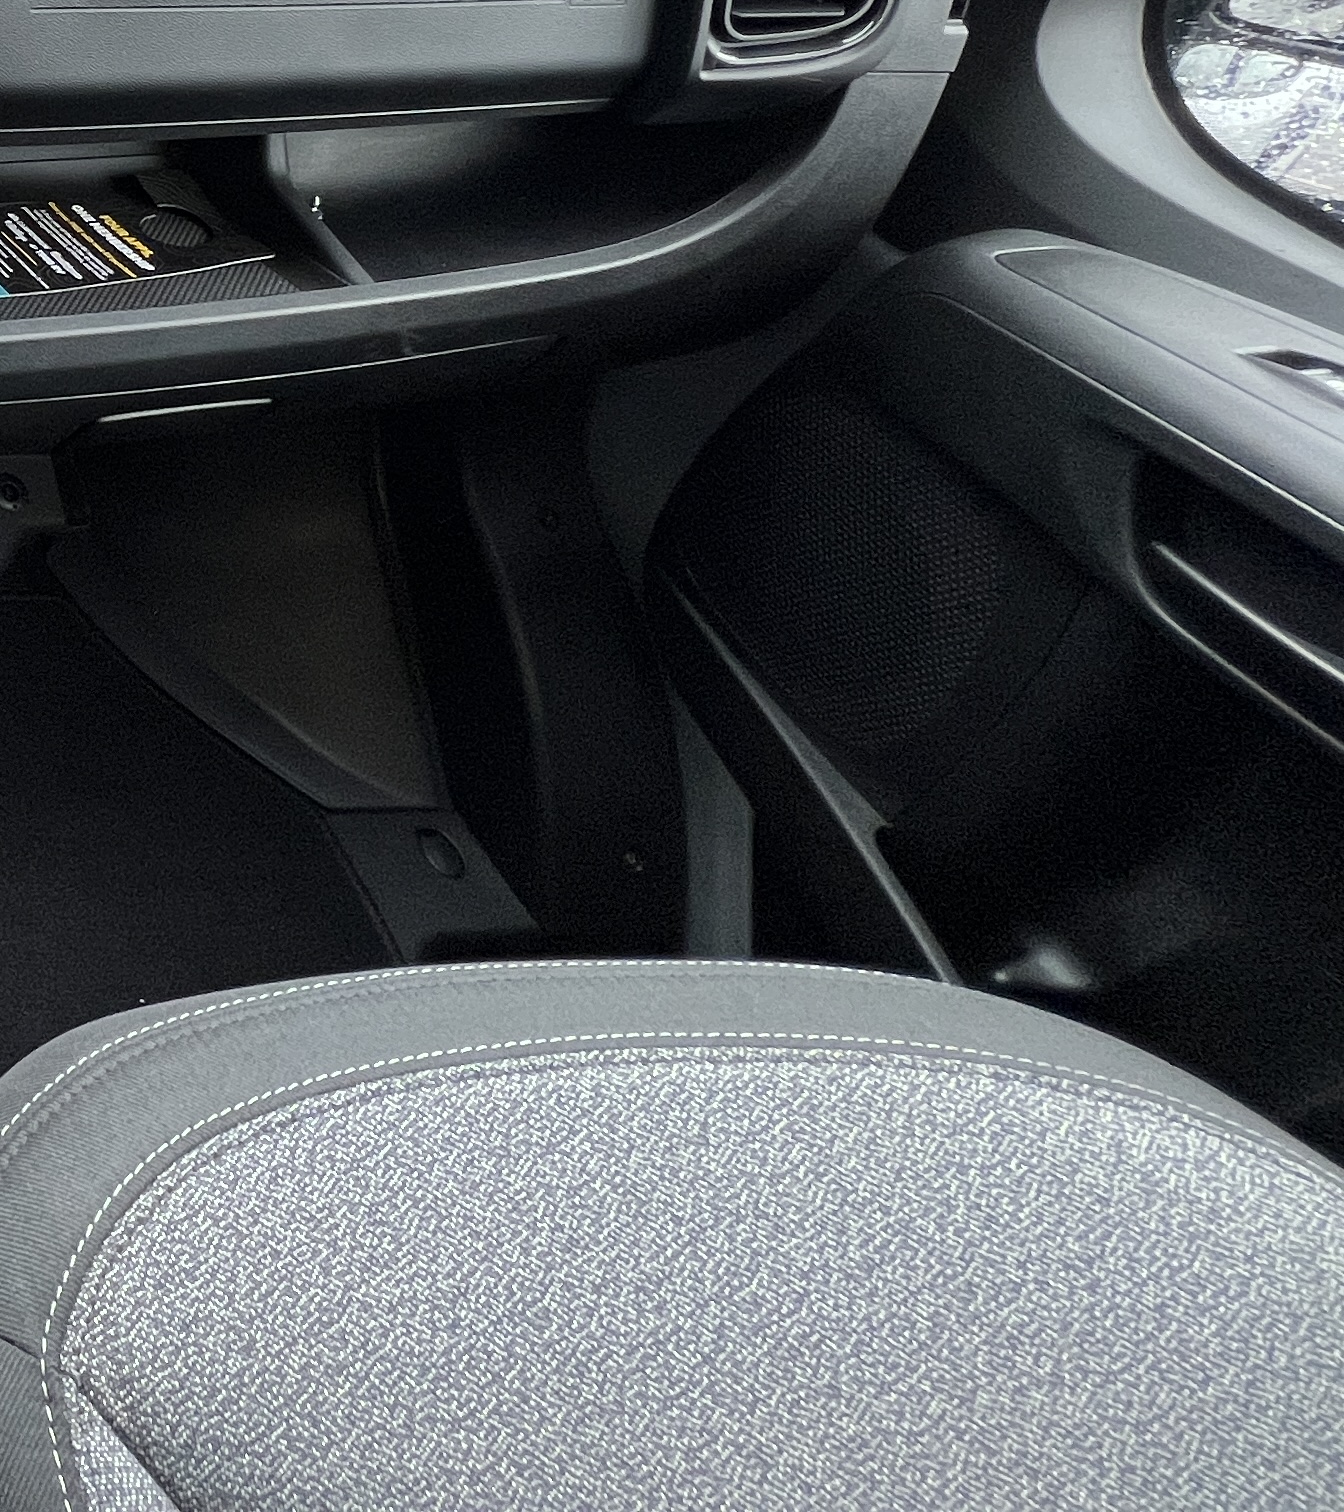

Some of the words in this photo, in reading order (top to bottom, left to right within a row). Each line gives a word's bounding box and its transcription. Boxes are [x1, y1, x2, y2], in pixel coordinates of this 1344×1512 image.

[71, 205, 96, 222] ONE
[89, 222, 155, 270] MEMBERSHIP
[99, 214, 129, 237] FOUR
